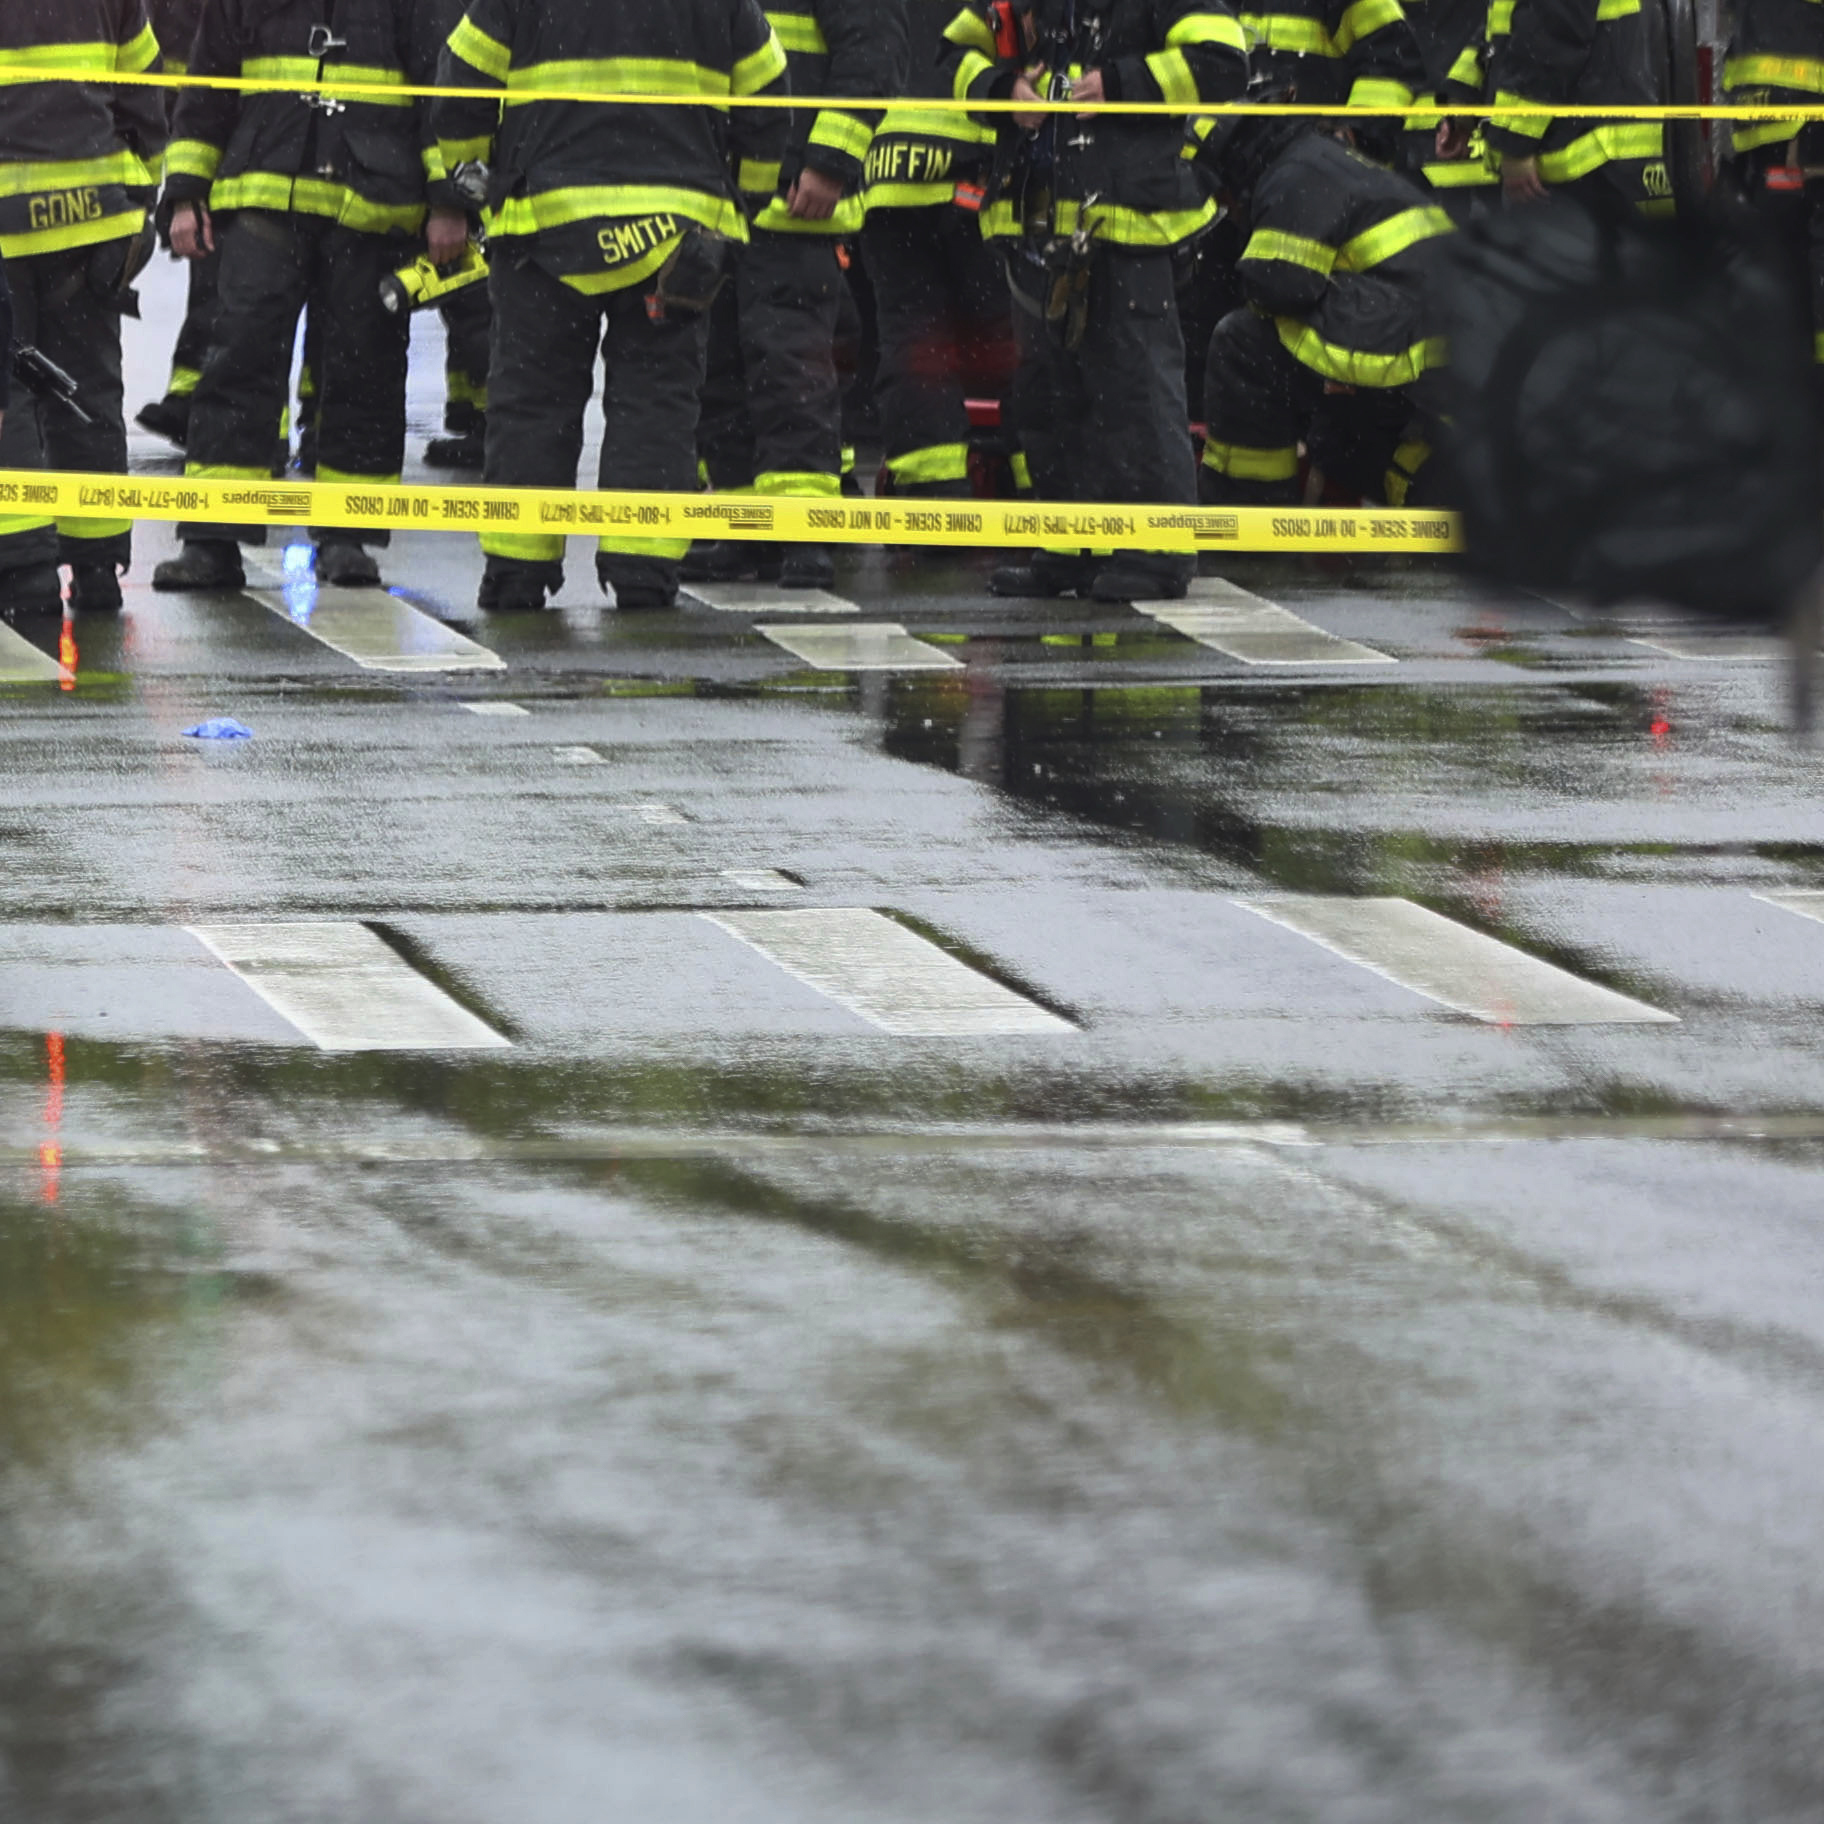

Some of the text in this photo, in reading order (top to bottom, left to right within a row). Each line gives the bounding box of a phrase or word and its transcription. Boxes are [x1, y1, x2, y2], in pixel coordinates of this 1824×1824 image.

[29, 187, 102, 229] GONG
[597, 213, 677, 264] SMITH
[21, 484, 58, 504] CRIME
[79, 486, 210, 510] 1-800-577-TIPS (8477)
[345, 495, 384, 515] CROSS
[386, 497, 410, 516] NOT
[412, 498, 429, 518] DO
[441, 500, 480, 520] SCENE
[481, 501, 520, 521] CRIME
[539, 501, 672, 526] 1-800-577-TIPS (8477)
[807, 508, 846, 529] CROSS
[848, 510, 872, 529] NOT
[875, 511, 891, 530] DO
[904, 512, 942, 532] SCENE
[944, 512, 983, 533] CRIME
[1004, 513, 1136, 536] 1-800-577-TIPS (8477)
[1271, 517, 1311, 537] CROSS
[1313, 518, 1337, 537] NOT
[1340, 519, 1356, 538] DO
[1369, 519, 1409, 539] SCENE
[1410, 519, 1450, 540] CRIME
